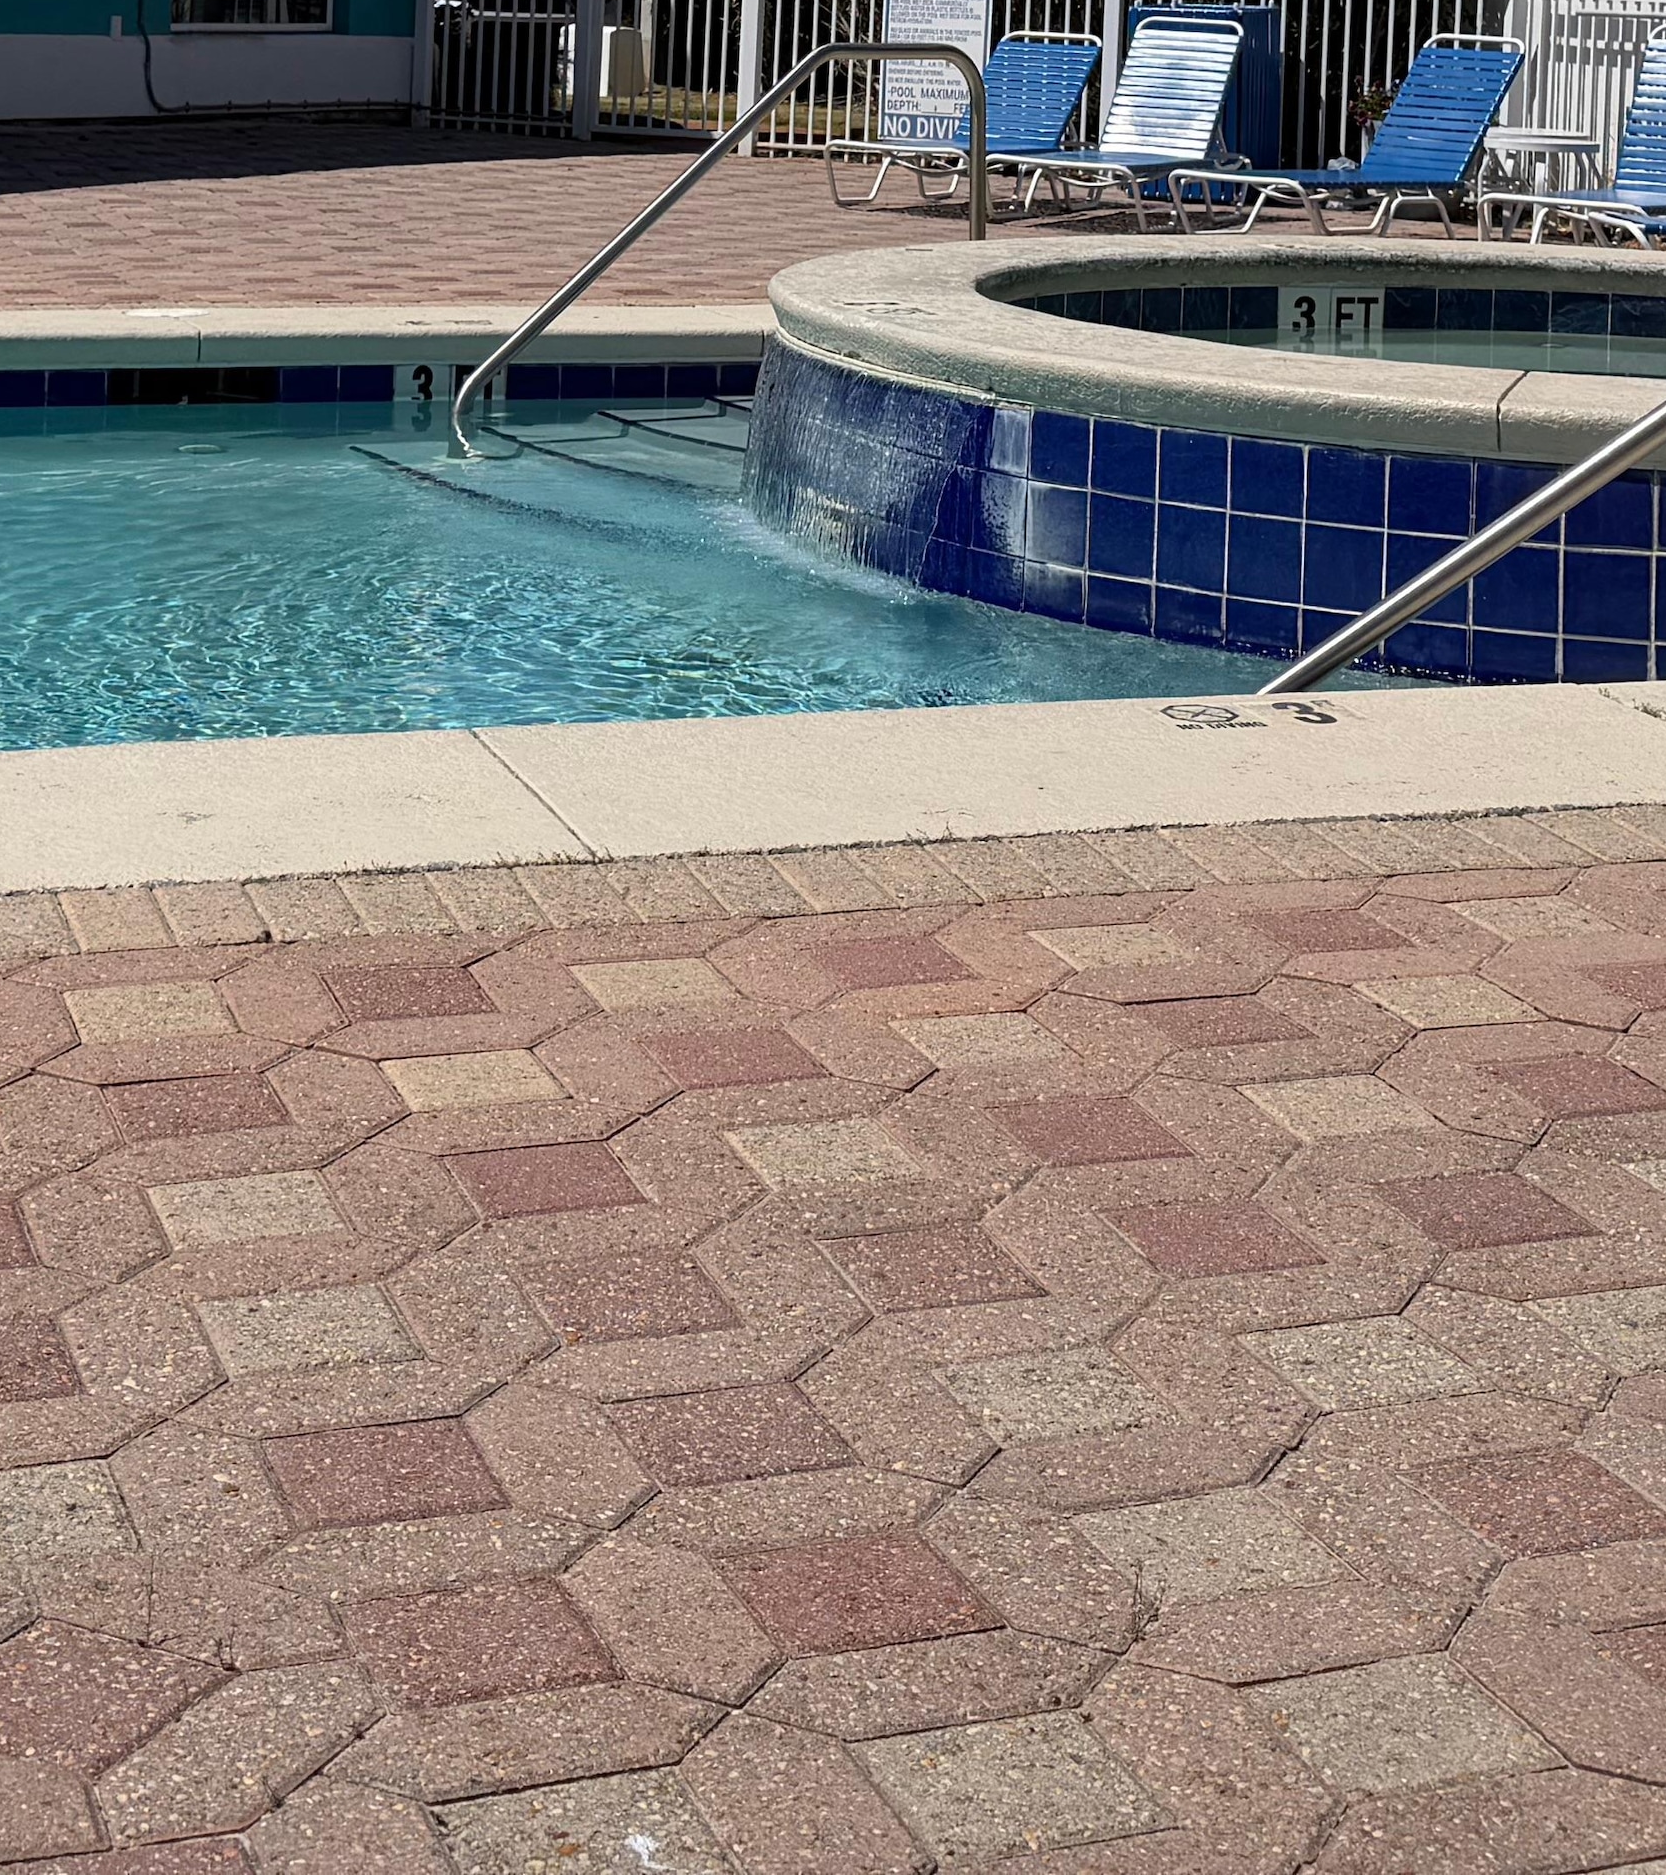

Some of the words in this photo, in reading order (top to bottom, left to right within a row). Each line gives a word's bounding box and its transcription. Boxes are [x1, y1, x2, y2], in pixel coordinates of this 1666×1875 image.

[920, 87, 970, 101] MAXIMUM
[884, 115, 911, 137] NO
[1292, 295, 1316, 328] 3
[1335, 296, 1379, 329] FT
[411, 365, 433, 401] 3
[1271, 702, 1338, 724] 3
